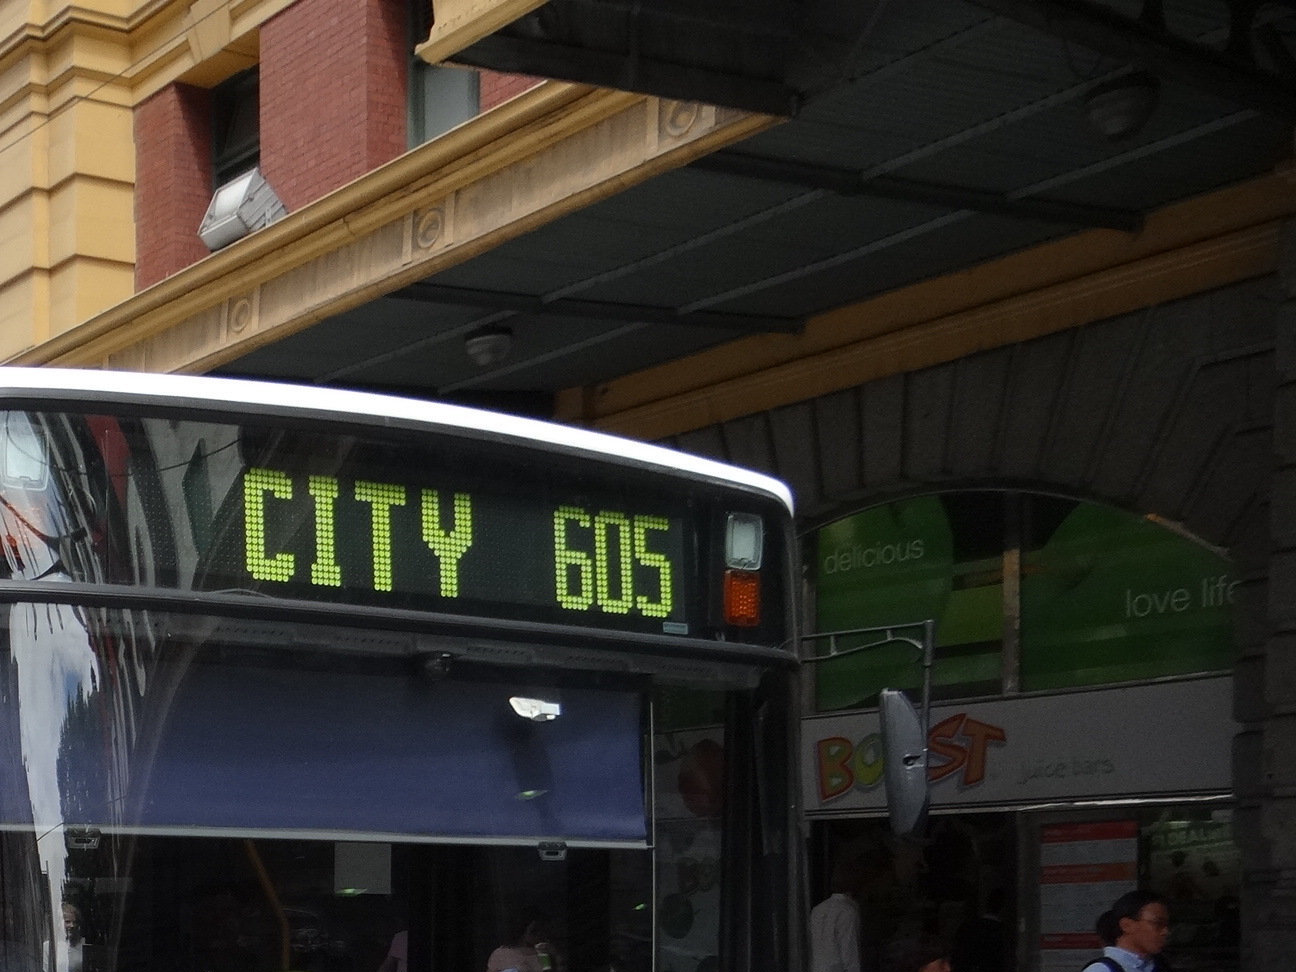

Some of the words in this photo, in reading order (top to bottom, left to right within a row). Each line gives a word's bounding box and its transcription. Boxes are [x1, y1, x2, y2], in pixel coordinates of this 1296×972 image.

[244, 467, 472, 598] CITY
[554, 506, 672, 618] 605
[824, 536, 925, 575] delicious
[1126, 585, 1191, 619] love
[816, 713, 1007, 802] BOST
